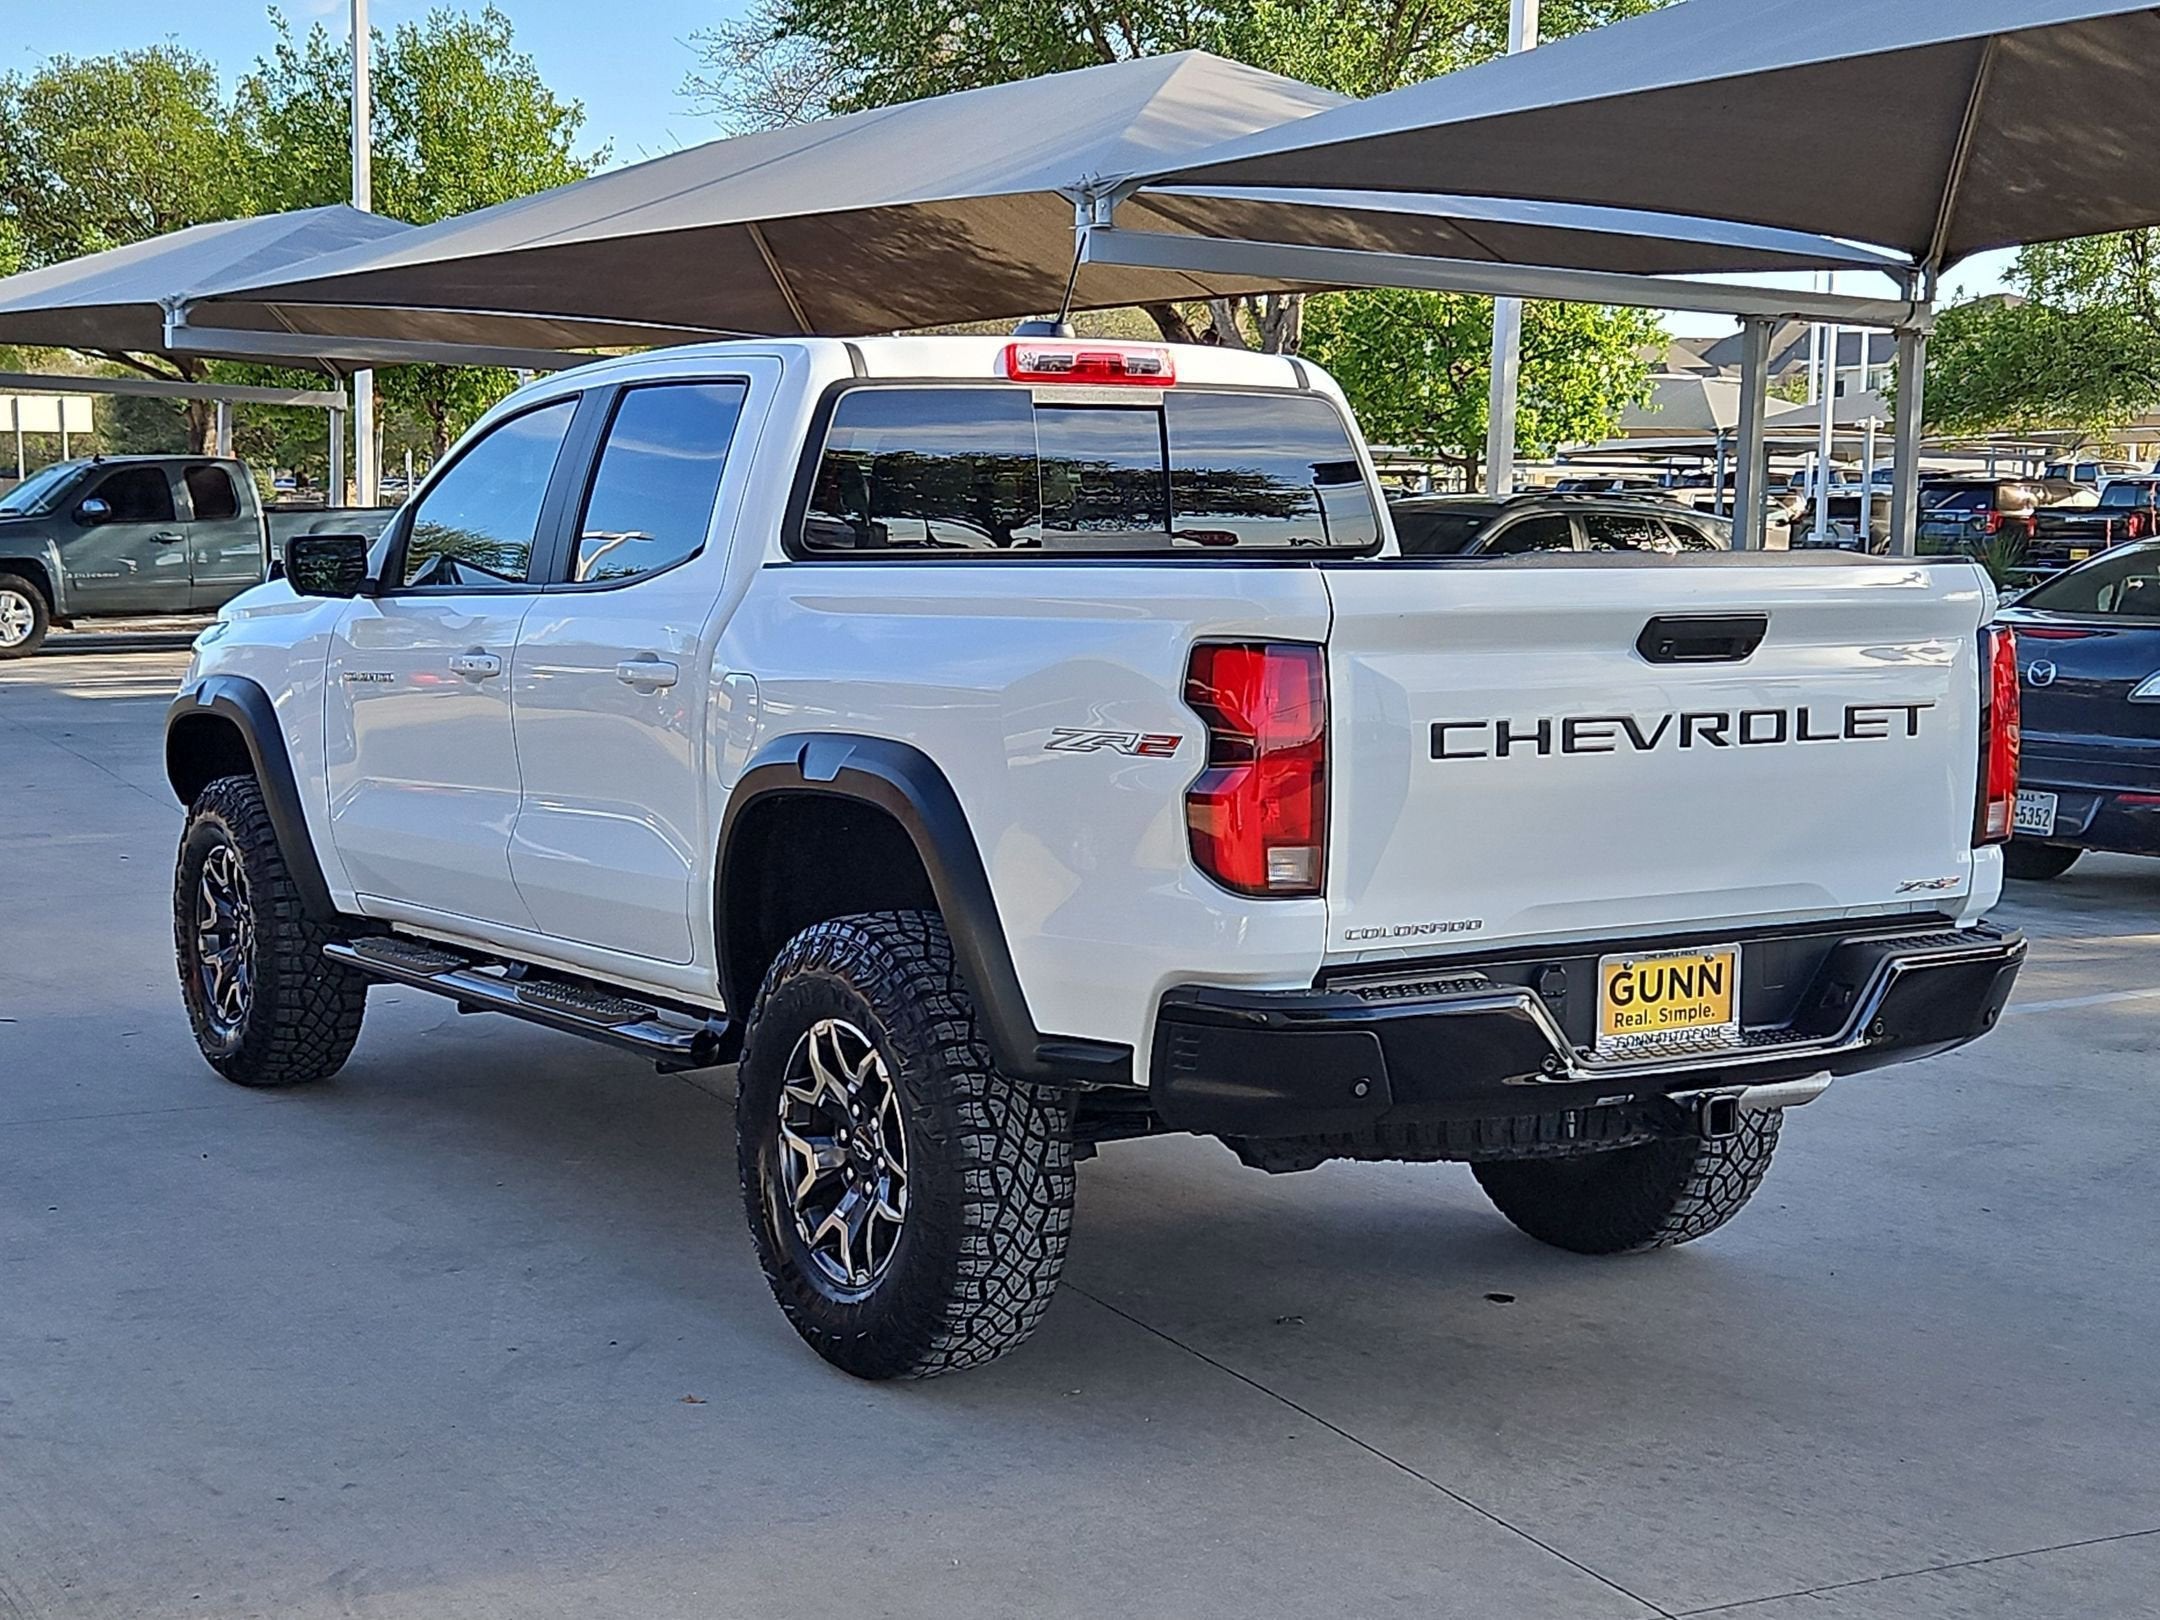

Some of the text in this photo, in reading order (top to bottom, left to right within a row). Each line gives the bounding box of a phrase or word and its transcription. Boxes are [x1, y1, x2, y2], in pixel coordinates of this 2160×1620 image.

[1043, 727, 1184, 758] ZR2
[1430, 701, 1937, 760] CHEVROLET
[2019, 805, 2051, 828] 5352
[1344, 919, 1483, 941] COLORADO
[1608, 962, 1723, 1007] GUNN
[1613, 1002, 1716, 1029] Real. Simple.
